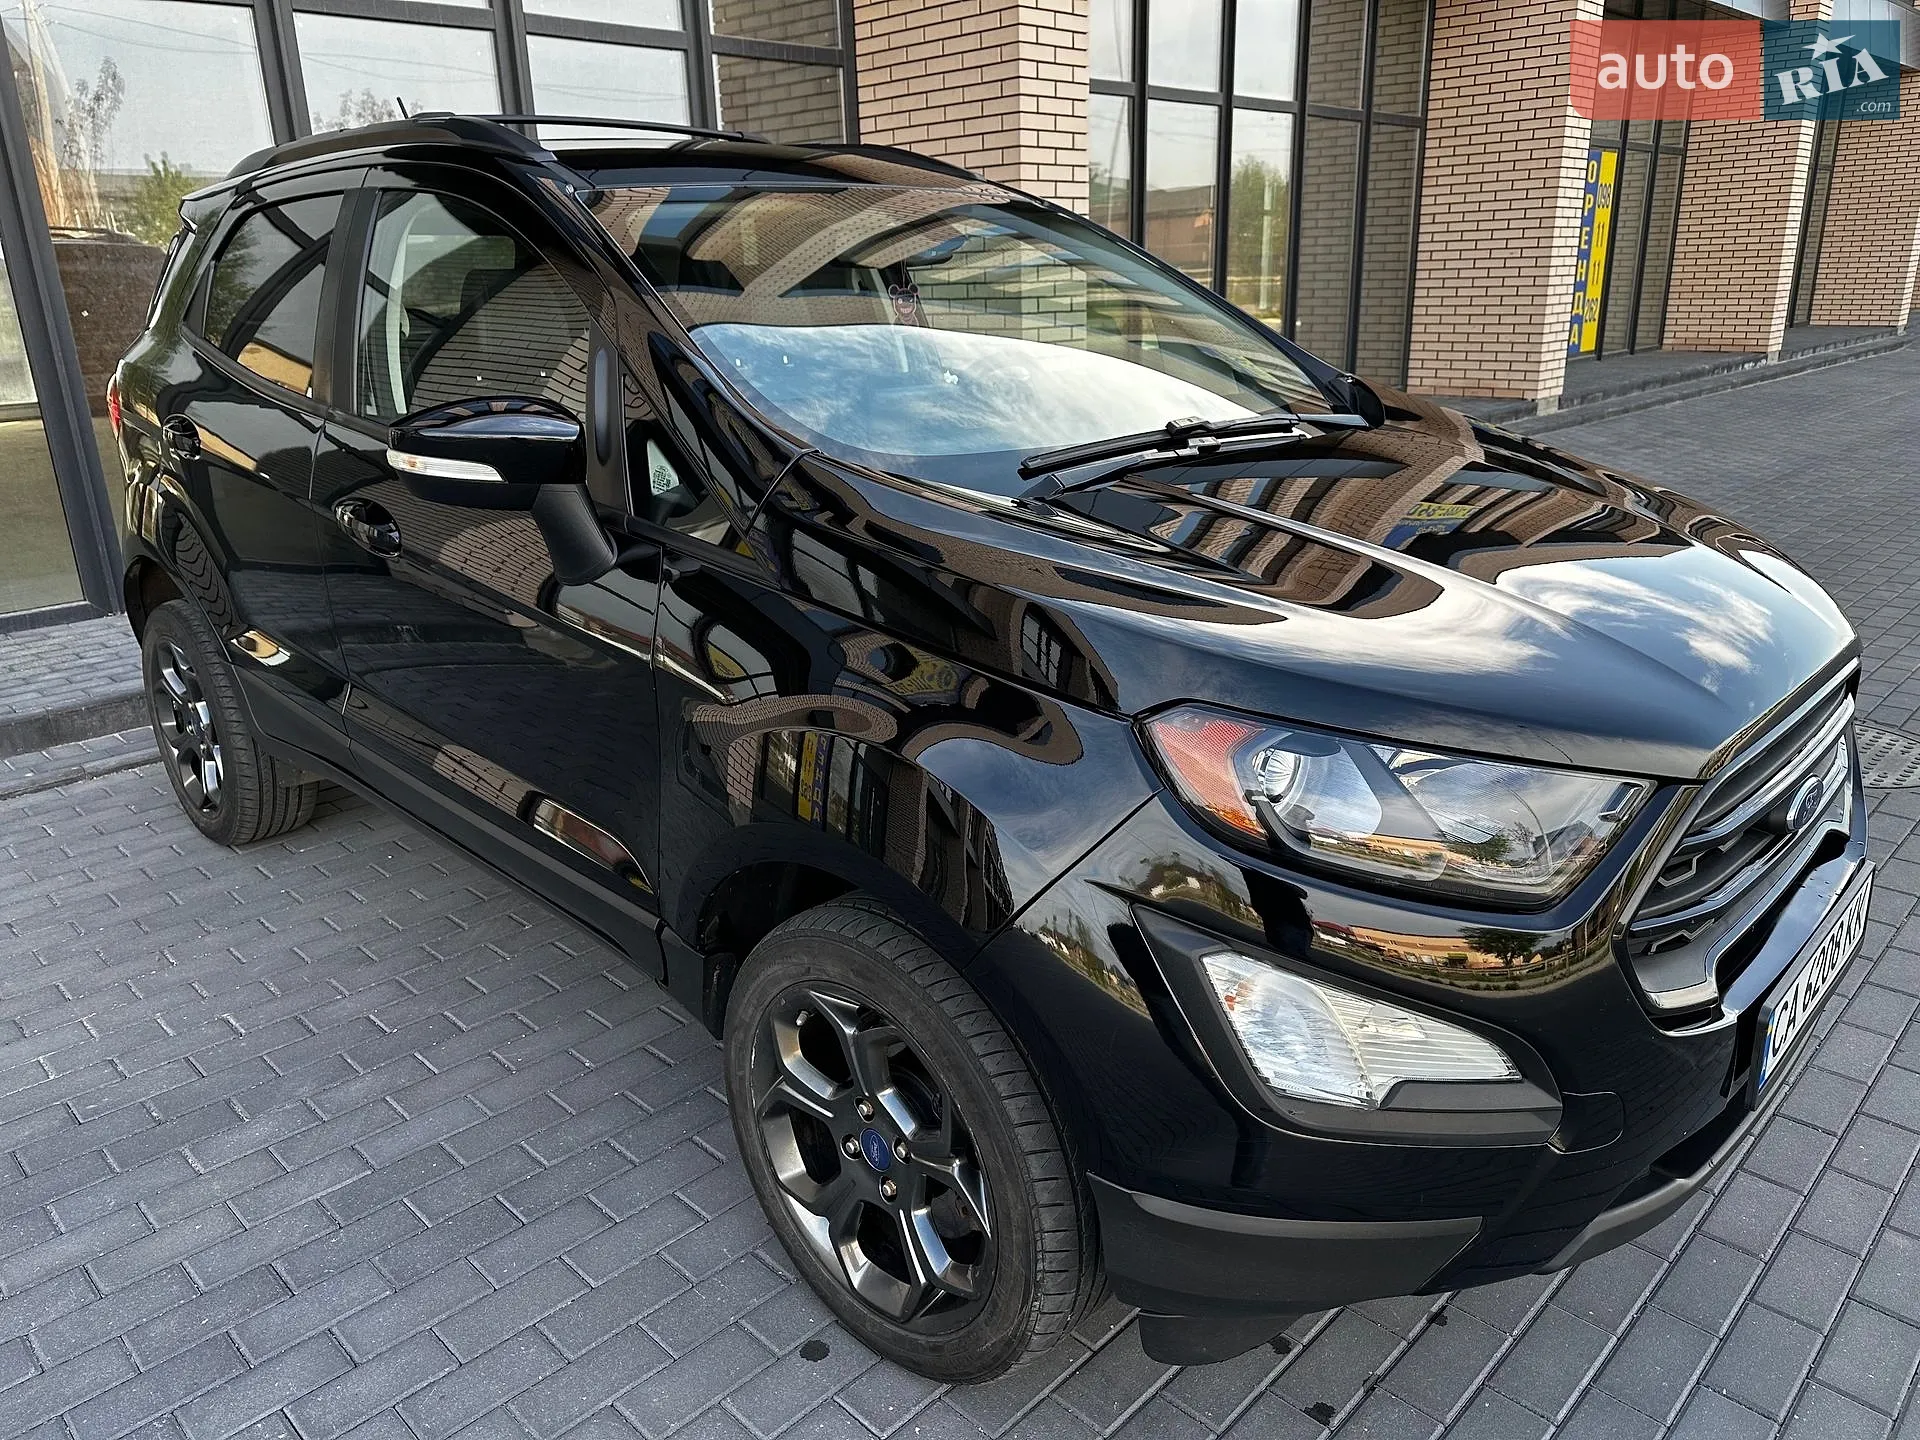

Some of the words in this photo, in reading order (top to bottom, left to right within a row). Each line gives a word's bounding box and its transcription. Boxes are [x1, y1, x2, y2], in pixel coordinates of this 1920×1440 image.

[1596, 183, 1612, 208] 098
[1596, 221, 1605, 248] 11
[1569, 160, 1597, 346] ОРЕНДА
[1592, 260, 1600, 285] 11
[1584, 298, 1599, 323] 262
[1772, 982, 1800, 1057] CA
[1802, 919, 1844, 1012] 6208
[1843, 882, 1869, 956] KK
